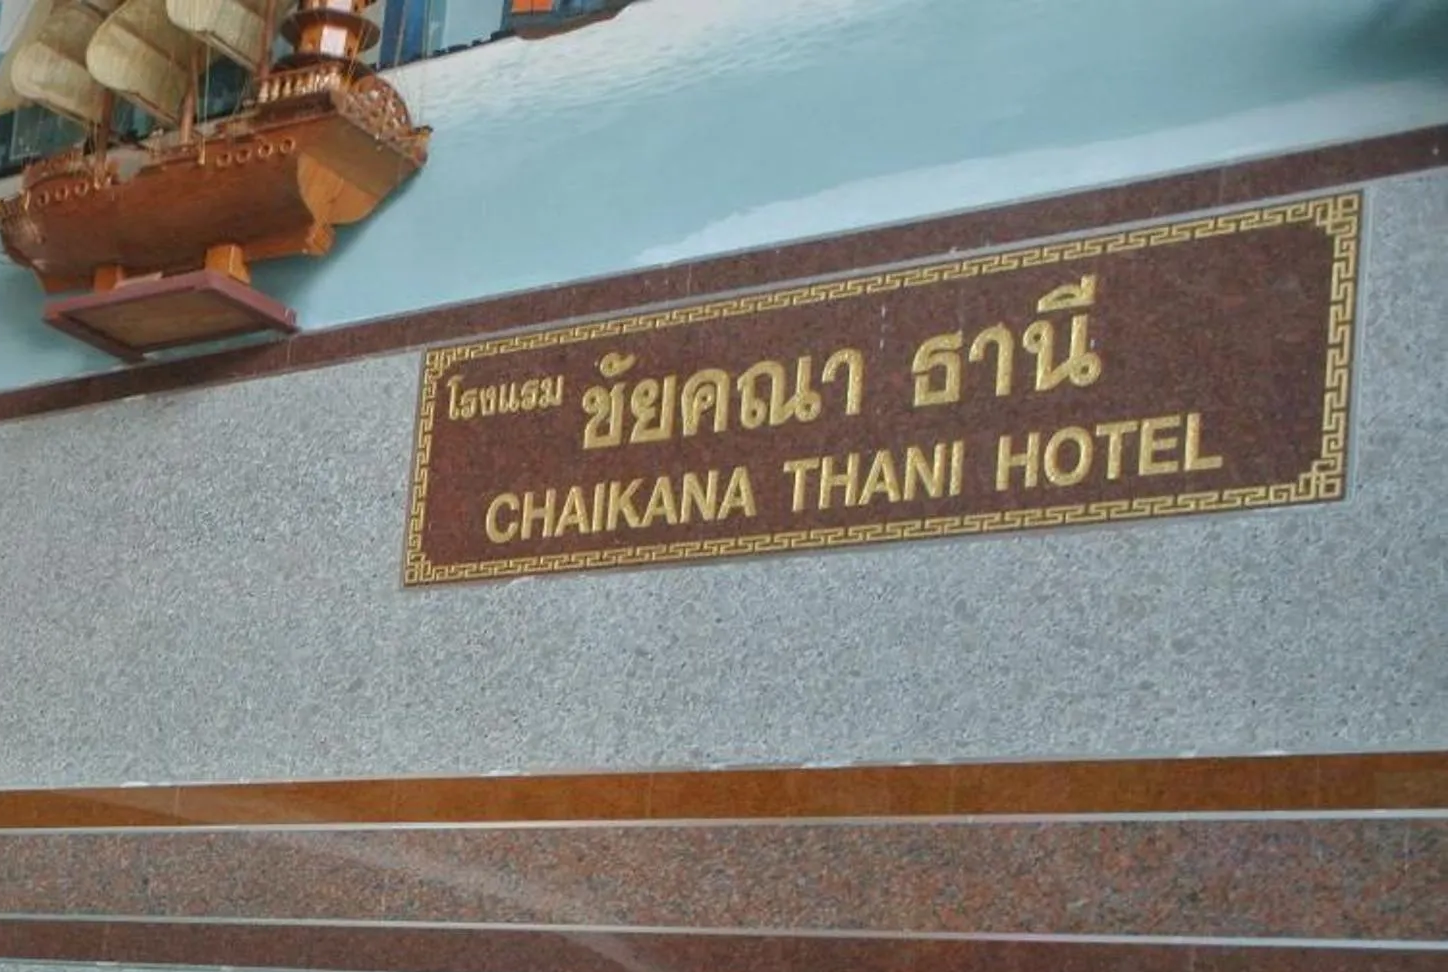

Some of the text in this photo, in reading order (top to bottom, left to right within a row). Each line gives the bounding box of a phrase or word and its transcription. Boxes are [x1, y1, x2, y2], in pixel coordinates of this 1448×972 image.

[447, 273, 1103, 451] โรงแรม ชัยคณา ธานี
[484, 412, 1224, 545] CHAIKANA THANI HOTEL
